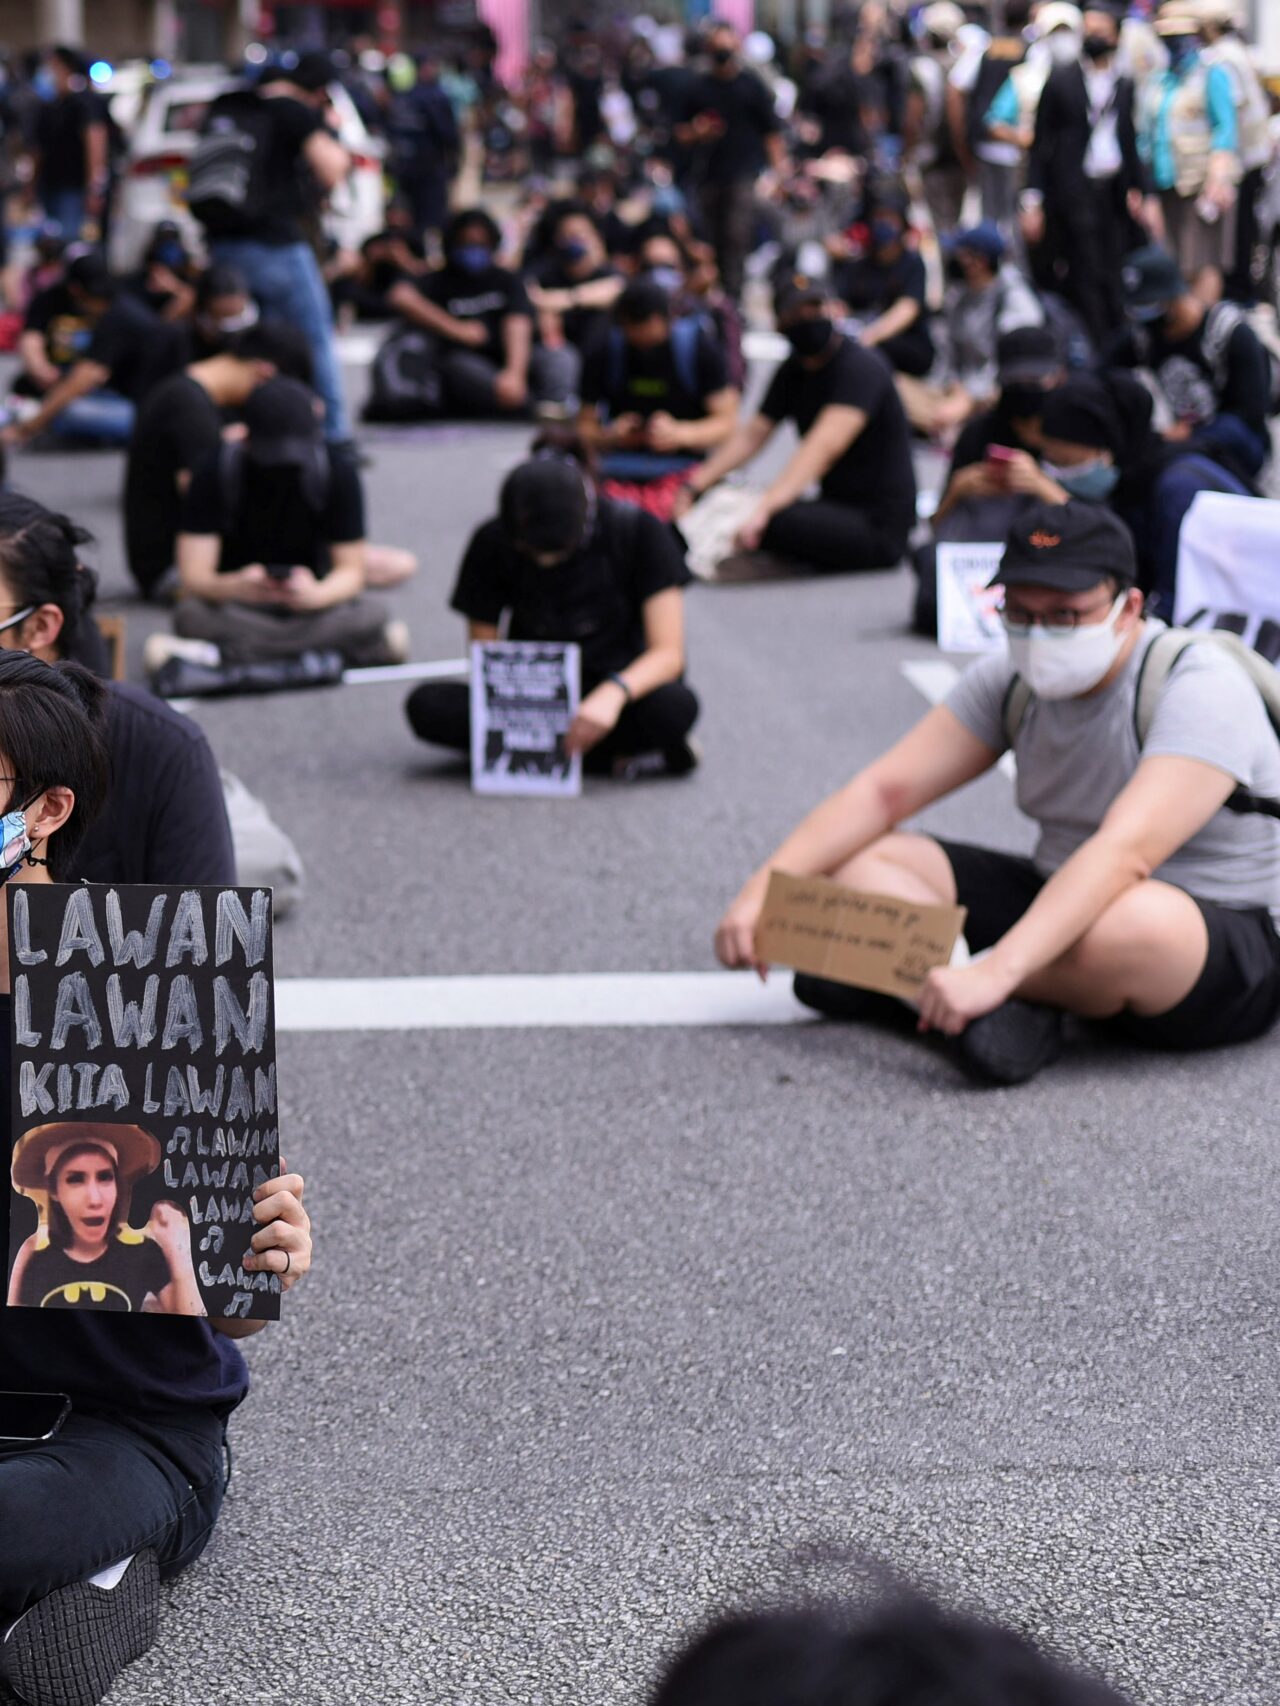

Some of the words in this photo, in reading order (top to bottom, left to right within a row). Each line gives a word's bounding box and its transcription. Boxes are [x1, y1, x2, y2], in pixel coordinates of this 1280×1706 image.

[13, 887, 270, 970] LAWAN
[14, 970, 270, 1057] LAWAN
[20, 1060, 130, 1117] KITA
[143, 1061, 276, 1122] LAWAN
[196, 1126, 279, 1158] LAWAN
[190, 1194, 258, 1226] LAWA
[198, 1260, 282, 1295] LAWAN
